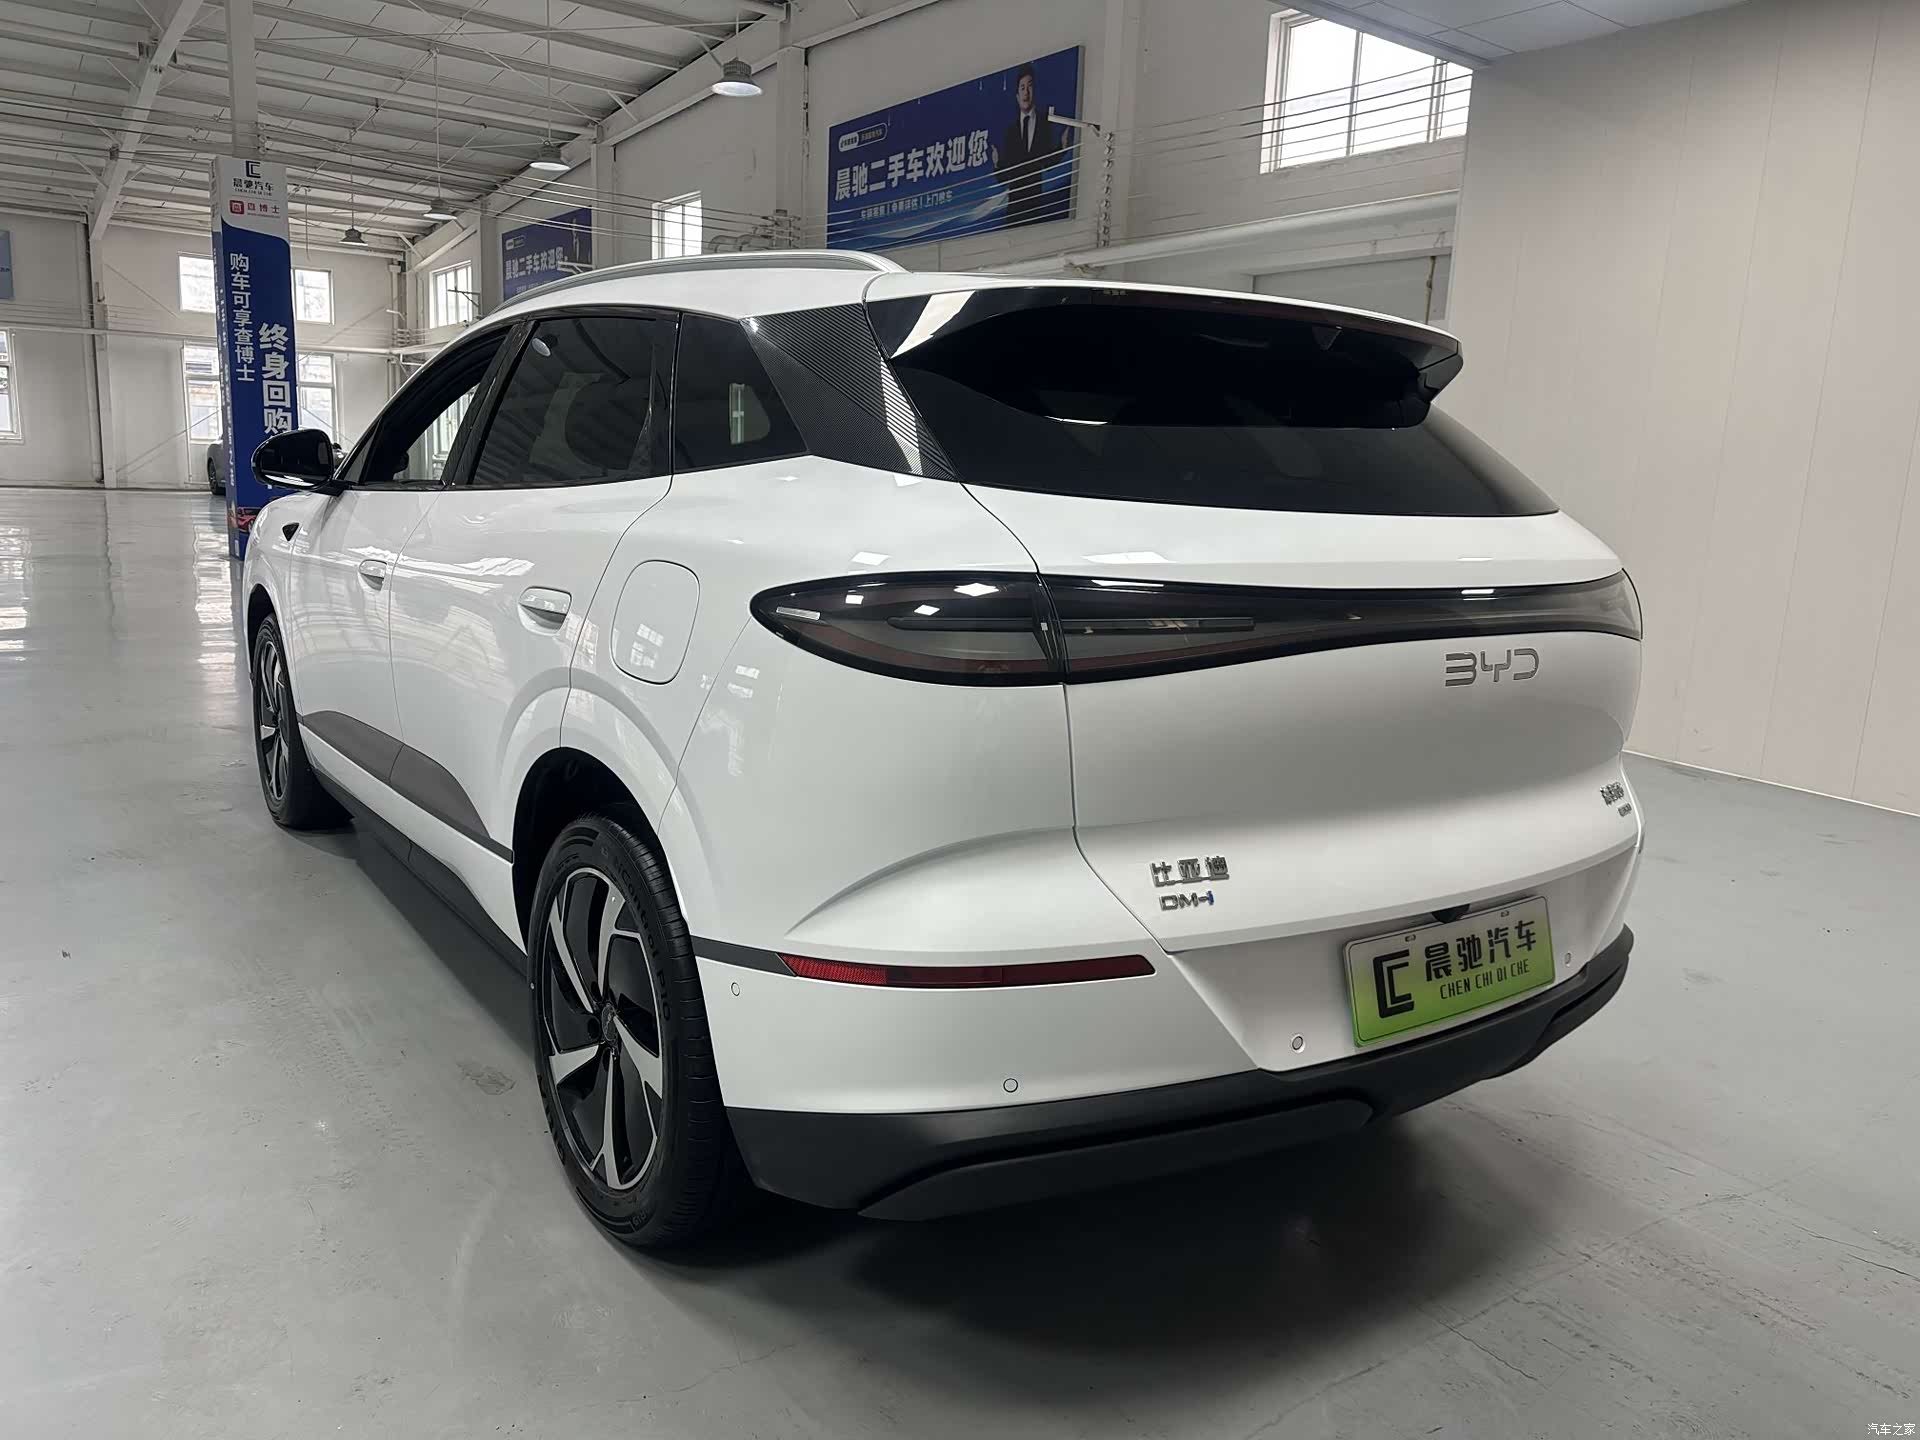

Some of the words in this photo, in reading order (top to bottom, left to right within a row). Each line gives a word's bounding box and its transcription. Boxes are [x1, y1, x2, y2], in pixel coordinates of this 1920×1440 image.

[835, 129, 989, 201] 晨驰二手车欢迎您
[230, 253, 256, 382] 购车可享查博士
[1445, 648, 1540, 687] BYD
[1150, 855, 1229, 888] 比亚迪
[1424, 920, 1537, 982] 晨驰汽车
[1440, 977, 1471, 1000] CHEN
[1475, 970, 1493, 989] CHI
[1511, 958, 1530, 977] CHE
